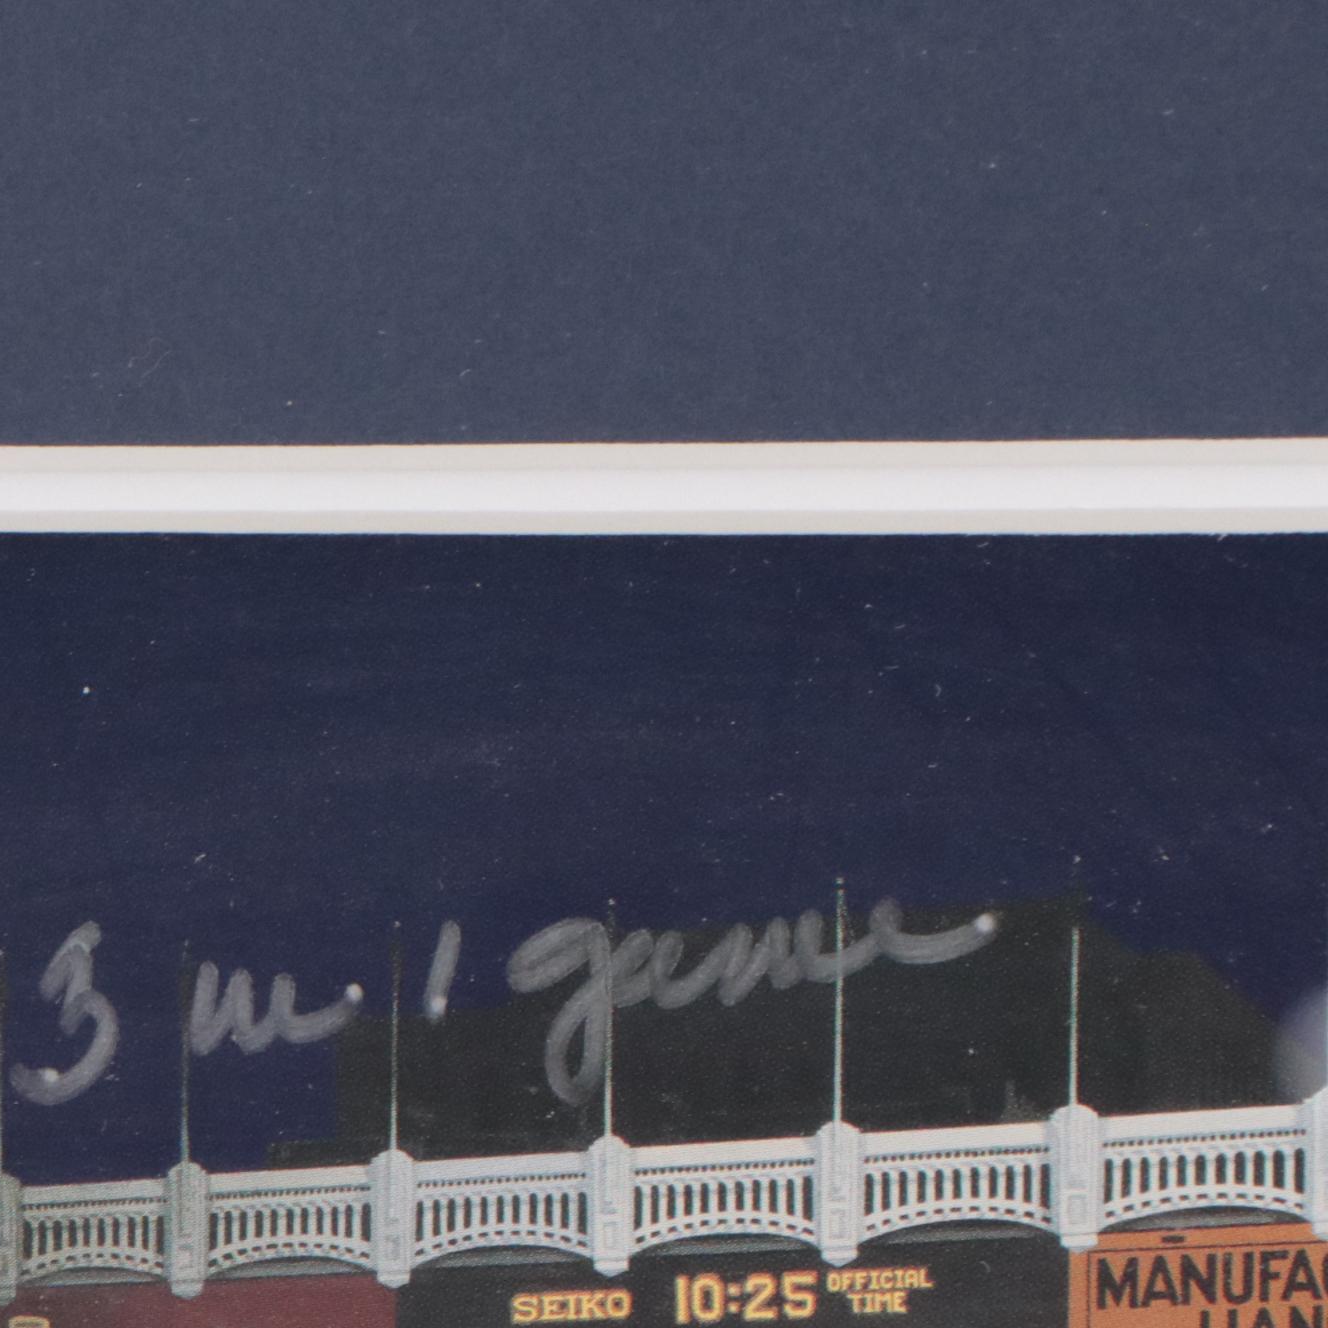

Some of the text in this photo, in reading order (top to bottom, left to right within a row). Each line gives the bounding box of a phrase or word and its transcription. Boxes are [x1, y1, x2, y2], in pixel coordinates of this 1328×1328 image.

[9, 920, 120, 1106] 3
[675, 1272, 818, 1324] 10:25
[826, 1267, 934, 1292] OFFICIAL
[1097, 1249, 1328, 1309] MANUFA
[510, 1288, 632, 1325] SEIKO
[846, 1291, 909, 1314] TIME
